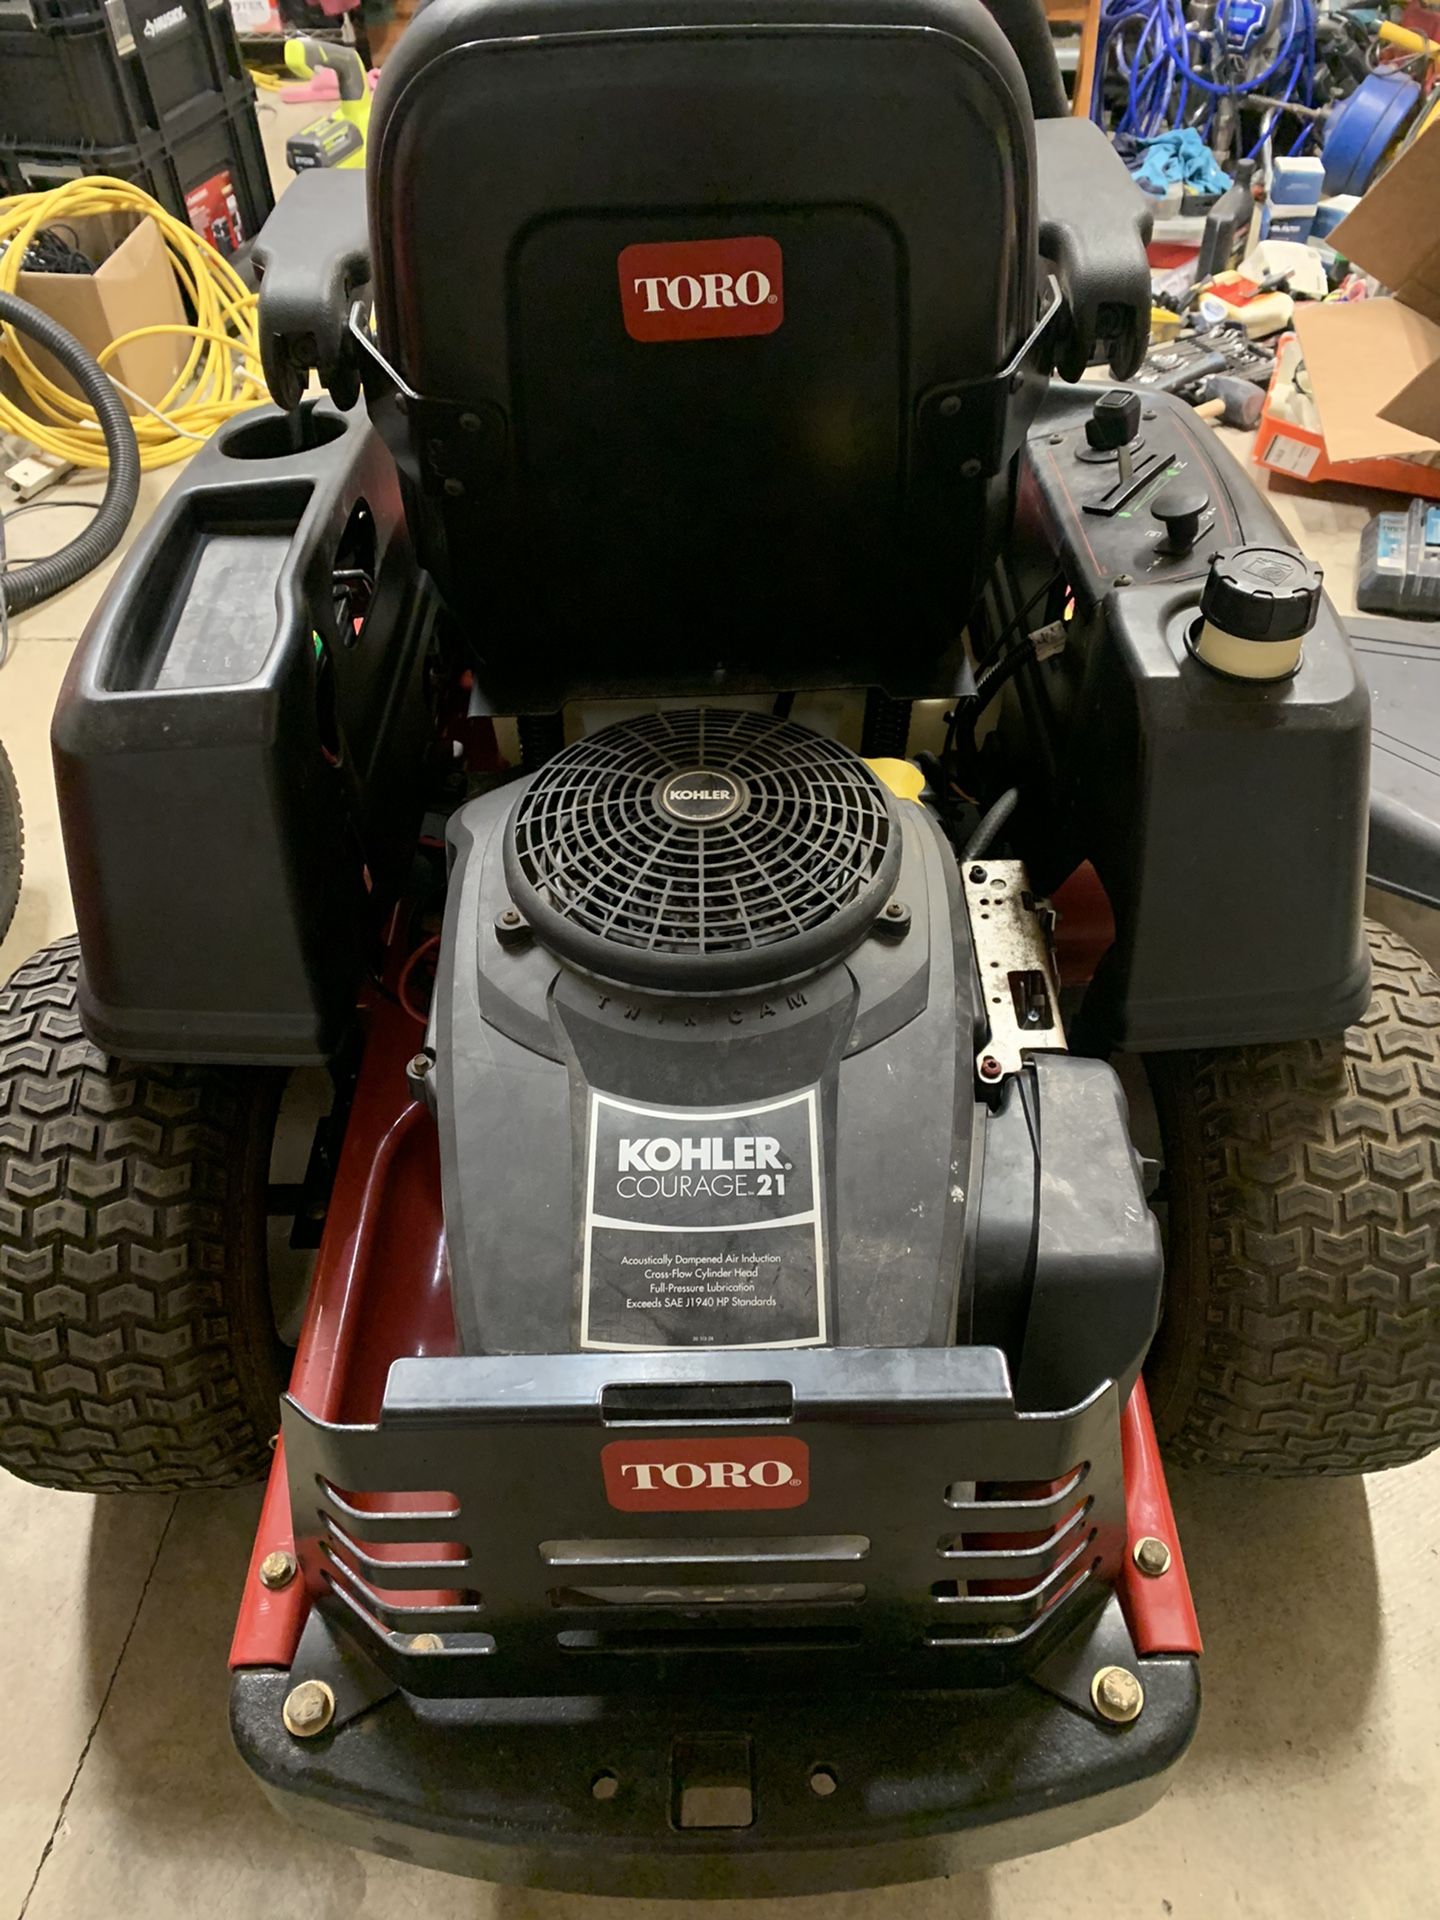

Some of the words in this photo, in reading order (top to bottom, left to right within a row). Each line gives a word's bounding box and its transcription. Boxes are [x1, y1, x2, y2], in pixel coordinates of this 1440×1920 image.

[634, 270, 771, 312] TORO
[669, 789, 731, 800] KOHLER
[728, 994, 808, 1025] CAM
[618, 1136, 785, 1172] KOHLER
[616, 1174, 748, 1199] COURAGE
[757, 1174, 785, 1196] 21
[621, 1254, 673, 1266] Acoustically
[675, 1253, 723, 1266] Dampened
[725, 1254, 739, 1263] Air
[741, 1253, 782, 1263] Induction
[644, 1268, 693, 1279] Cross-Flow
[695, 1268, 732, 1280] Cylinder
[734, 1267, 759, 1278] Head
[650, 1283, 705, 1293] Full-Pressure
[707, 1282, 755, 1292] Lubrication
[626, 1298, 662, 1308] Exceeds
[664, 1298, 684, 1308] SAE
[685, 1297, 715, 1308] J1940
[716, 1297, 730, 1307] HP
[731, 1296, 777, 1307] Standards
[621, 1460, 794, 1490] TORO
